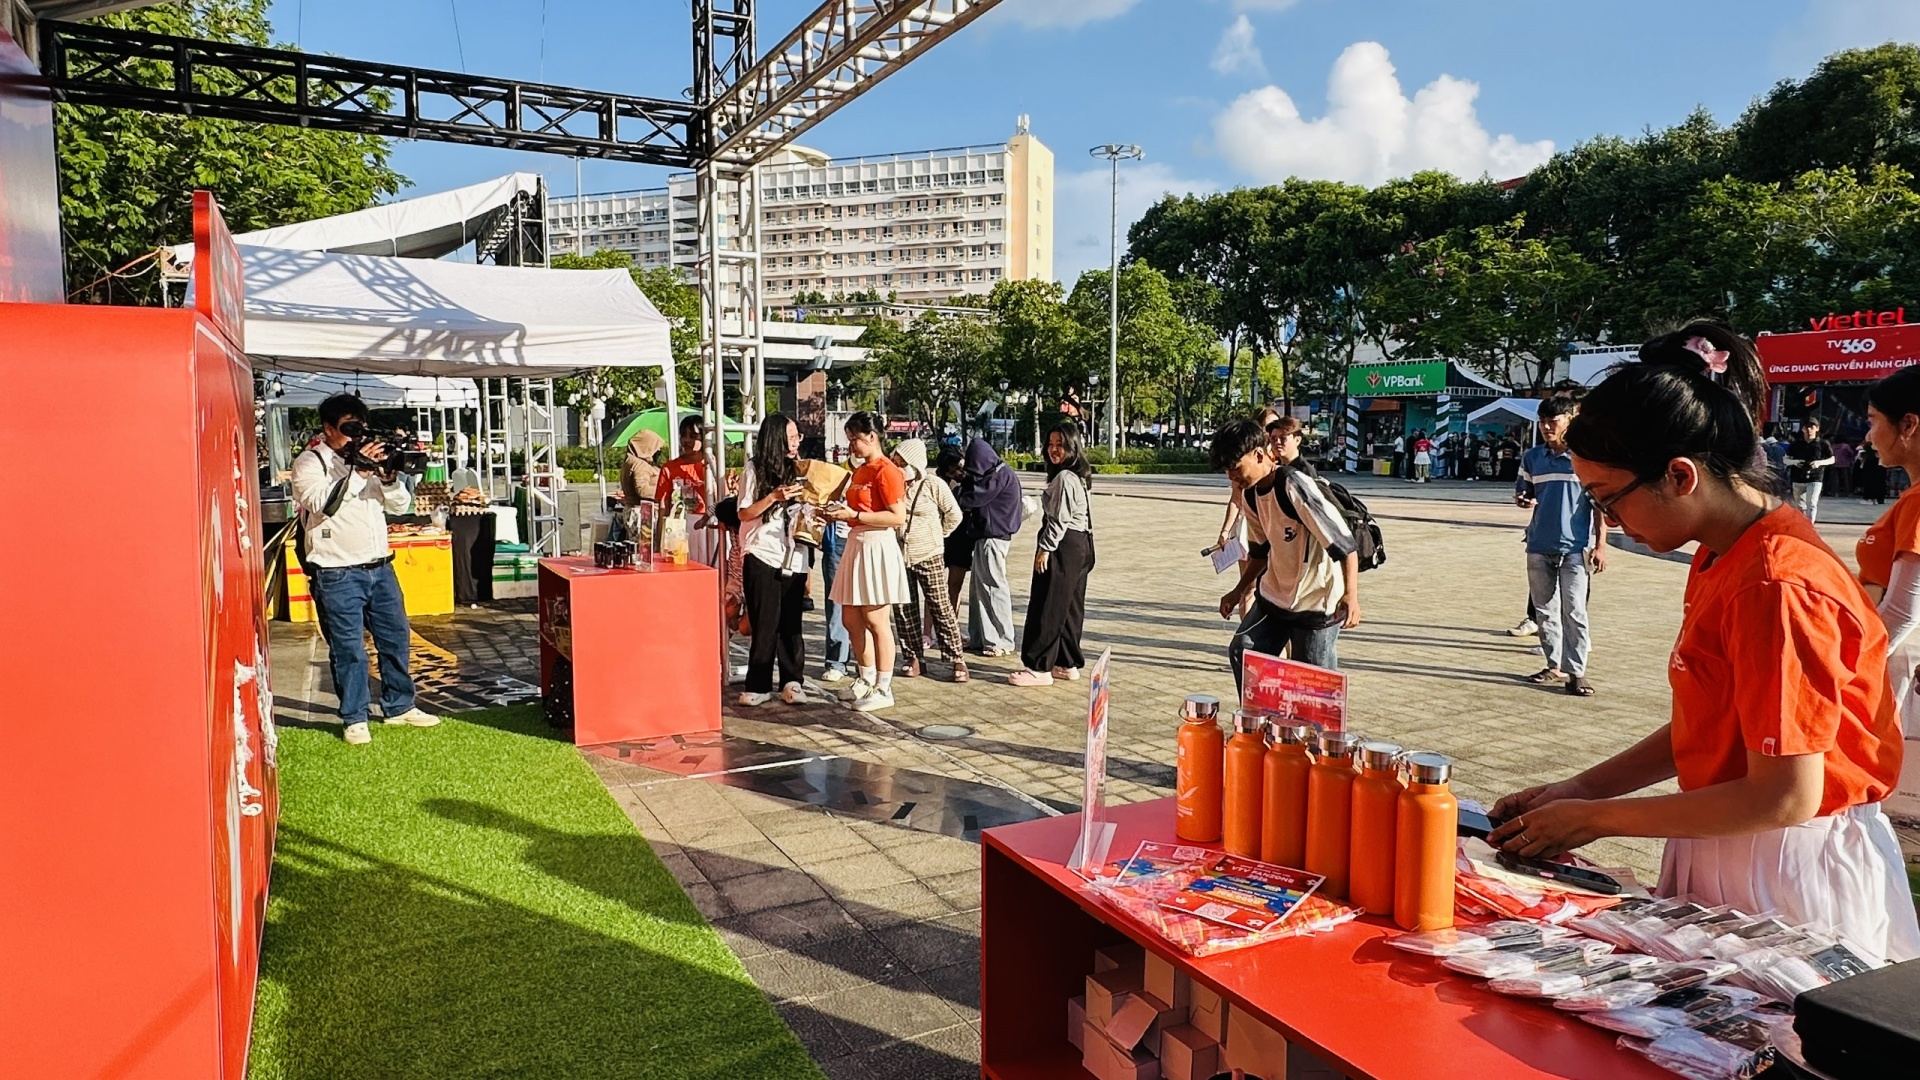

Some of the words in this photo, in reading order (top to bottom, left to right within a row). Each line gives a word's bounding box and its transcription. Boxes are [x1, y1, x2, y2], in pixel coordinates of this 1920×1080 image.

[1810, 307, 1907, 331] viettel
[1826, 338, 1876, 354] TV360
[1769, 364, 1790, 373] ỨNG
[1791, 363, 1820, 373] DỤNG
[1821, 359, 1865, 371] TRUYỀN
[1865, 358, 1893, 369] HÌNH
[1383, 374, 1426, 387] VPBank
[1258, 682, 1277, 696] VTV
[1231, 865, 1251, 873] VTV
[1251, 869, 1295, 884] FANZONE
